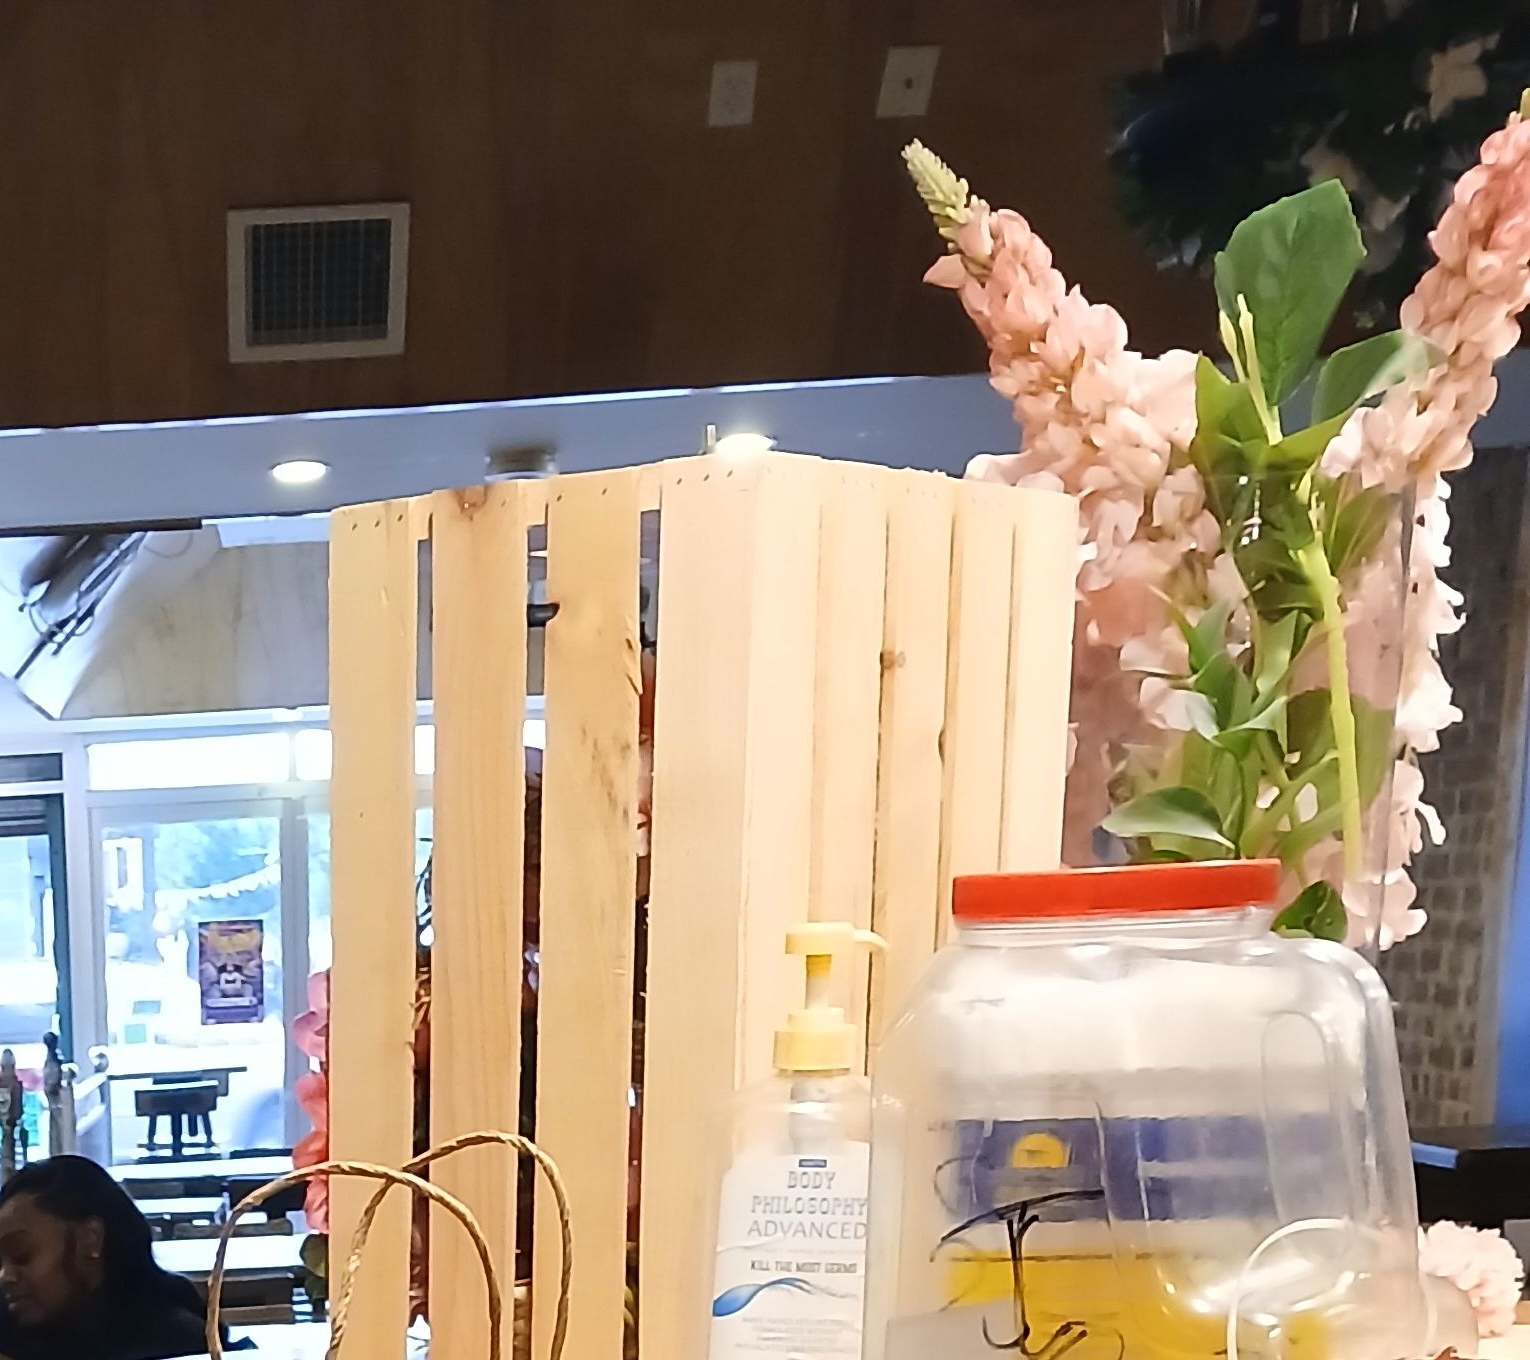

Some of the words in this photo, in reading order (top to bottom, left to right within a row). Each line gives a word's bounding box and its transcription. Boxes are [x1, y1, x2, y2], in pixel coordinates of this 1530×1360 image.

[787, 1171, 836, 1189] BODY
[751, 1195, 869, 1215] PHILOSOPHY
[747, 1220, 867, 1239] ADVANCED
[751, 1260, 770, 1271] KILL
